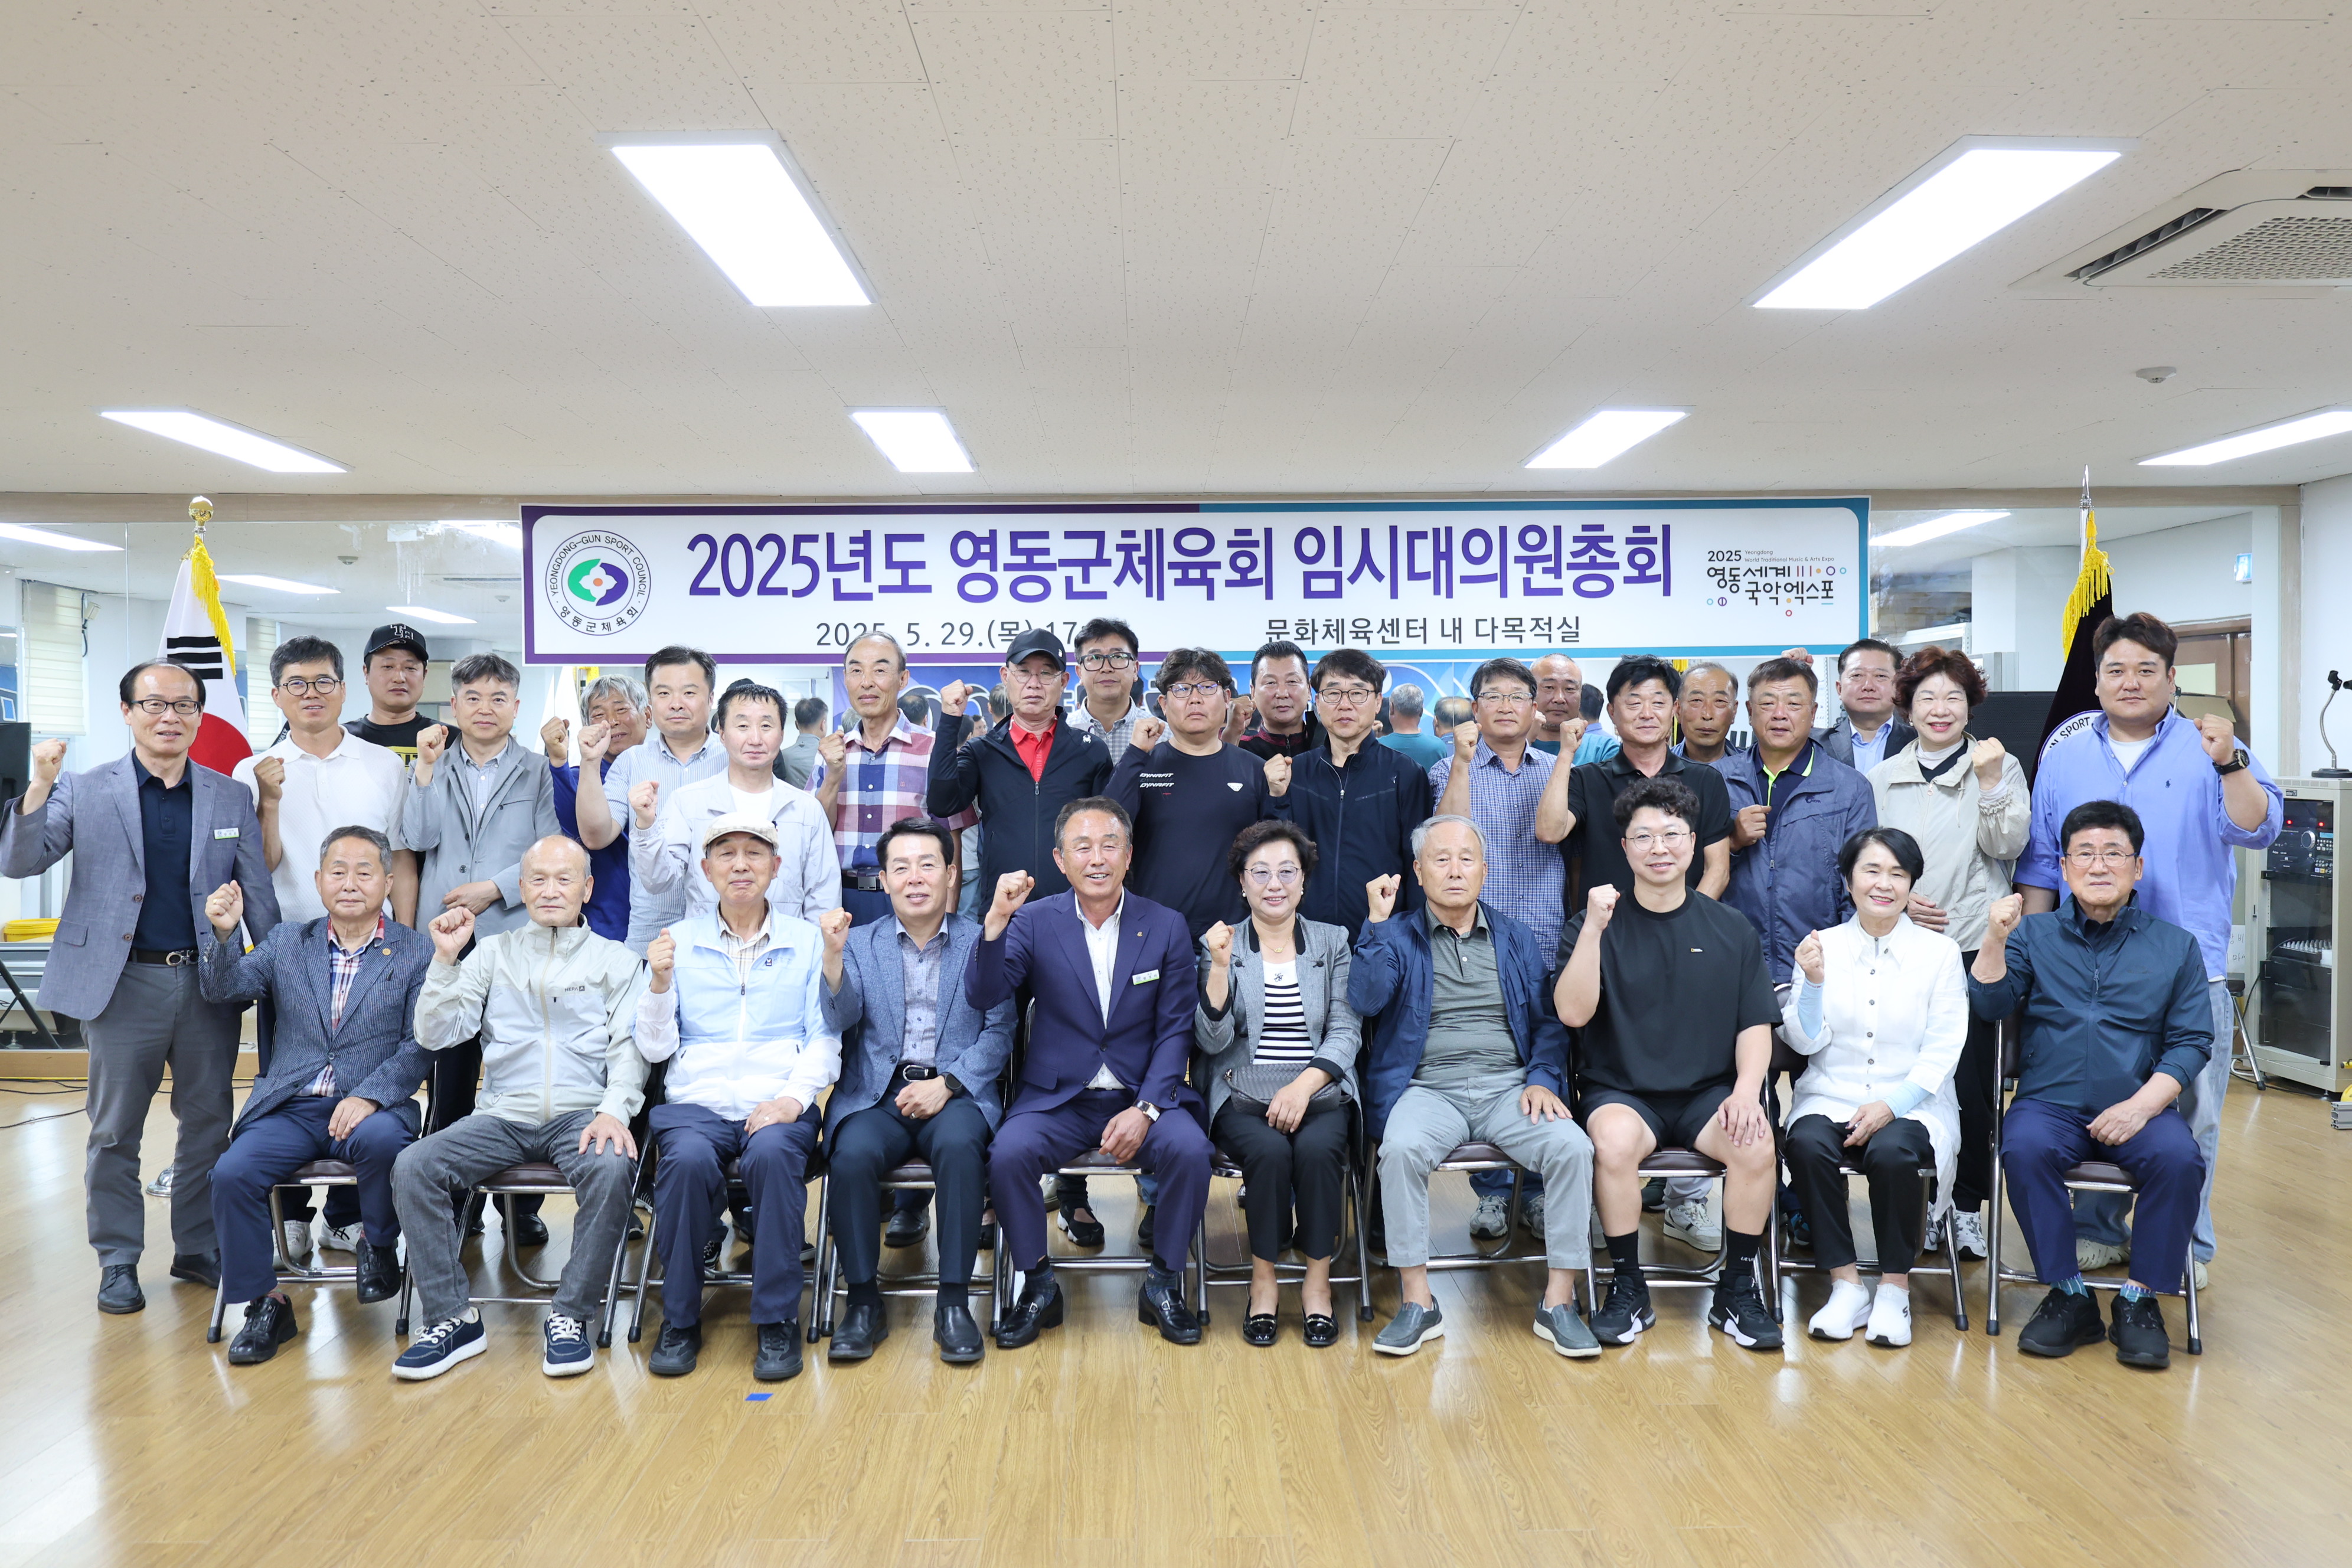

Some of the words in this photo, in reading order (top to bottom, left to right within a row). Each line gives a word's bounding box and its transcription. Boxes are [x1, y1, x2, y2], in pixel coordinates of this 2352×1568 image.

[550, 534, 602, 597] YEONGDONG-GUN
[605, 535, 635, 556] SPORT
[632, 556, 647, 597] COUNCIL
[687, 530, 932, 602] 2025년도
[949, 527, 1273, 603] 영동군체육회
[1293, 524, 1671, 600] 임시대의원총회
[1707, 550, 1742, 562] 2025
[1707, 566, 1791, 594] 영동세계
[1745, 580, 1834, 606] 국악엑스포
[560, 606, 639, 633] 영동군체육회
[1265, 617, 1427, 646] 문화체육센터
[1440, 617, 1462, 645] 내
[1475, 616, 1580, 644] 다목적실
[2060, 716, 2090, 739] SPORT
